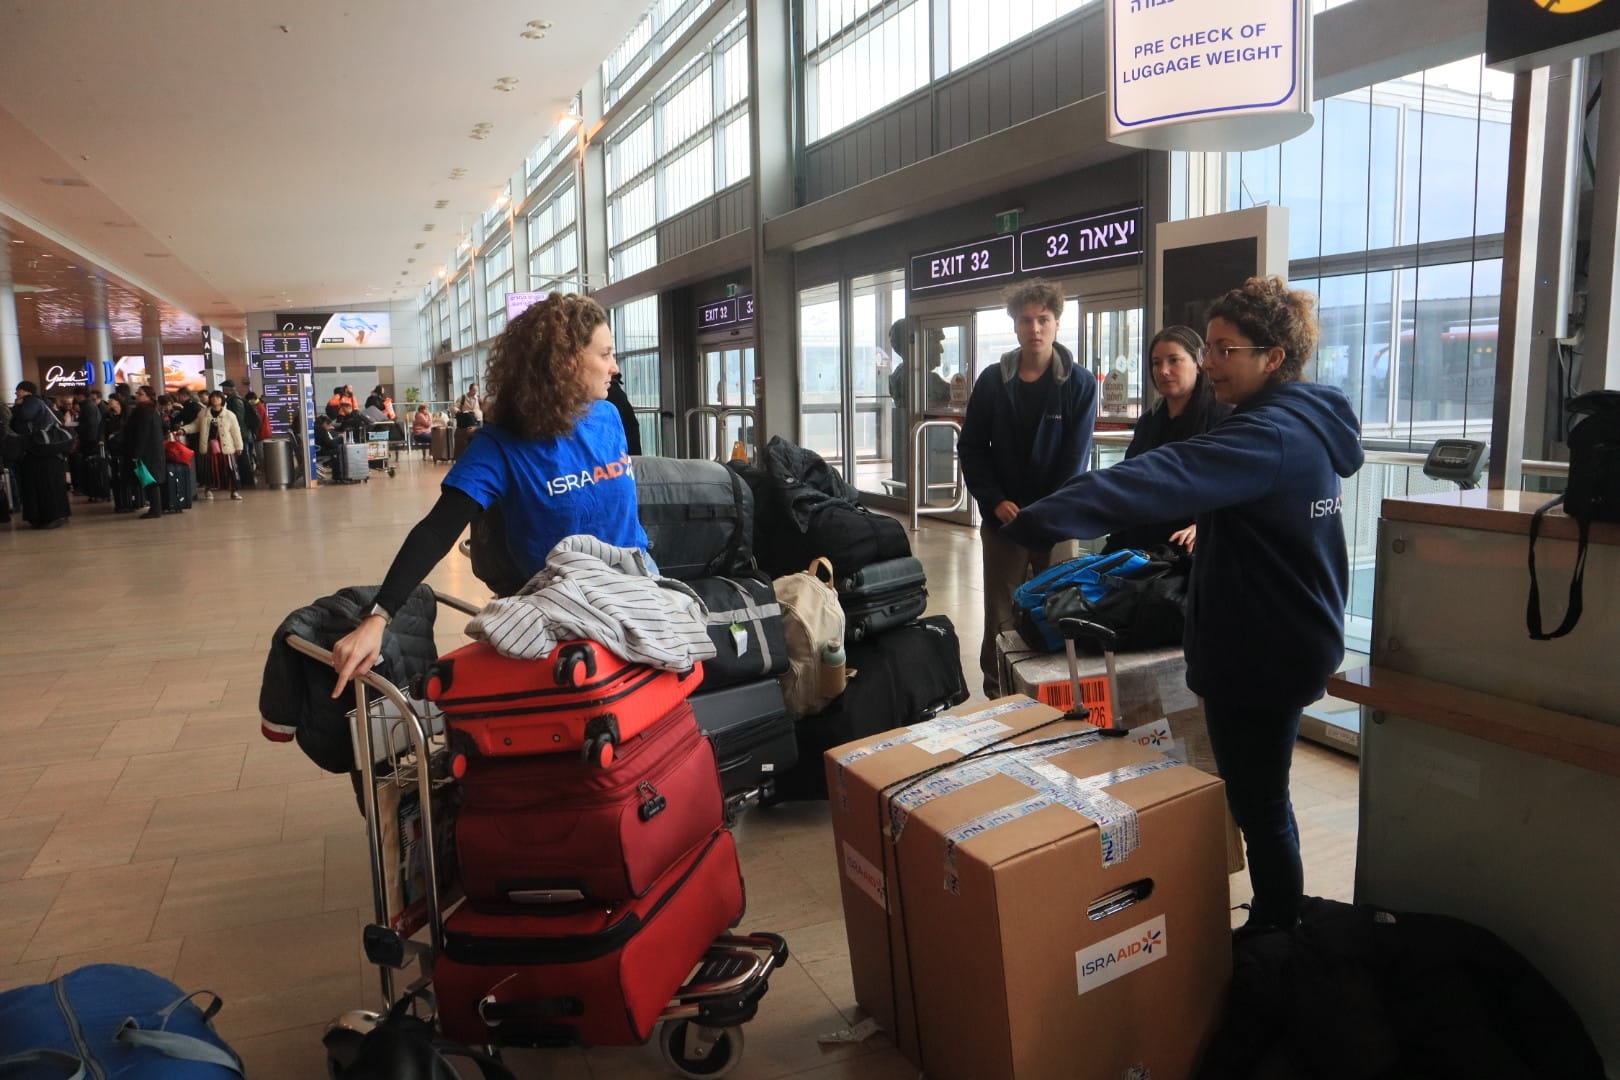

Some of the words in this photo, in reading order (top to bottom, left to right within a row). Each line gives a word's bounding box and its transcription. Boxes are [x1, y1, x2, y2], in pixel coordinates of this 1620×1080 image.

[1134, 40, 1164, 59] PRE
[1169, 27, 1233, 50] CHECK
[1240, 23, 1266, 39] OF
[1123, 55, 1201, 83] LUGGAGE
[1206, 45, 1282, 66] WEIGHT
[1046, 233, 1069, 258] 32
[1079, 219, 1135, 252] יציאה
[931, 254, 965, 279] EXIT
[971, 250, 990, 272] 32
[705, 307, 718, 321] EXIT
[720, 306, 728, 319] 32
[546, 461, 624, 497] ISRAAID
[987, 813, 1014, 828] NUF
[1019, 801, 1046, 815] NUF
[956, 825, 985, 840] NUF
[1101, 831, 1113, 862] NUF
[1081, 941, 1142, 977] ISRAAID
